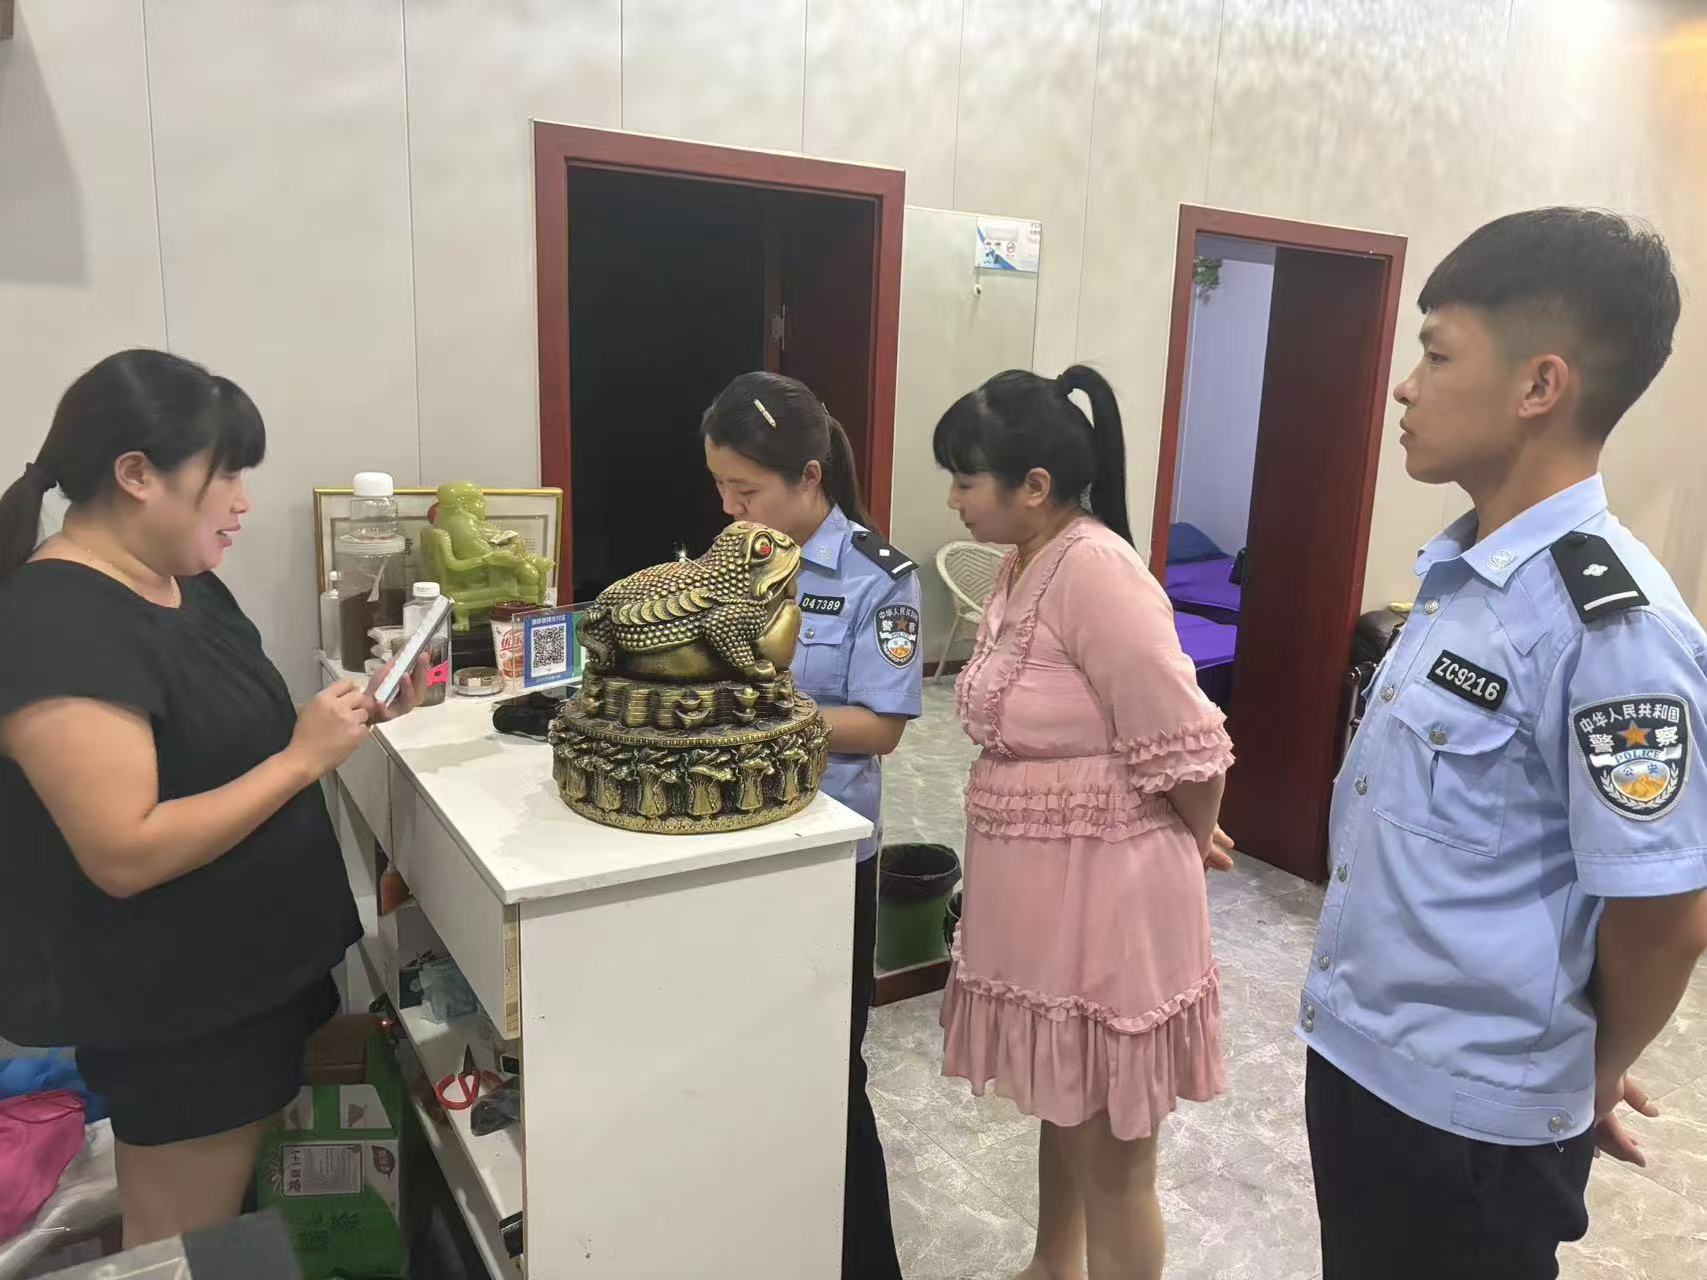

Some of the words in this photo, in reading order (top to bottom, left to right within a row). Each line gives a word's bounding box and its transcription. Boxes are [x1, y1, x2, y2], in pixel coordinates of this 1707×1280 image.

[802, 597, 841, 611] 047389
[1434, 657, 1501, 701] ZC9216
[1579, 702, 1680, 734] 中华人民共和国
[1588, 733, 1615, 753] 警
[1654, 725, 1679, 747] 察
[1614, 749, 1660, 763] POLICE
[1622, 765, 1634, 777] 公
